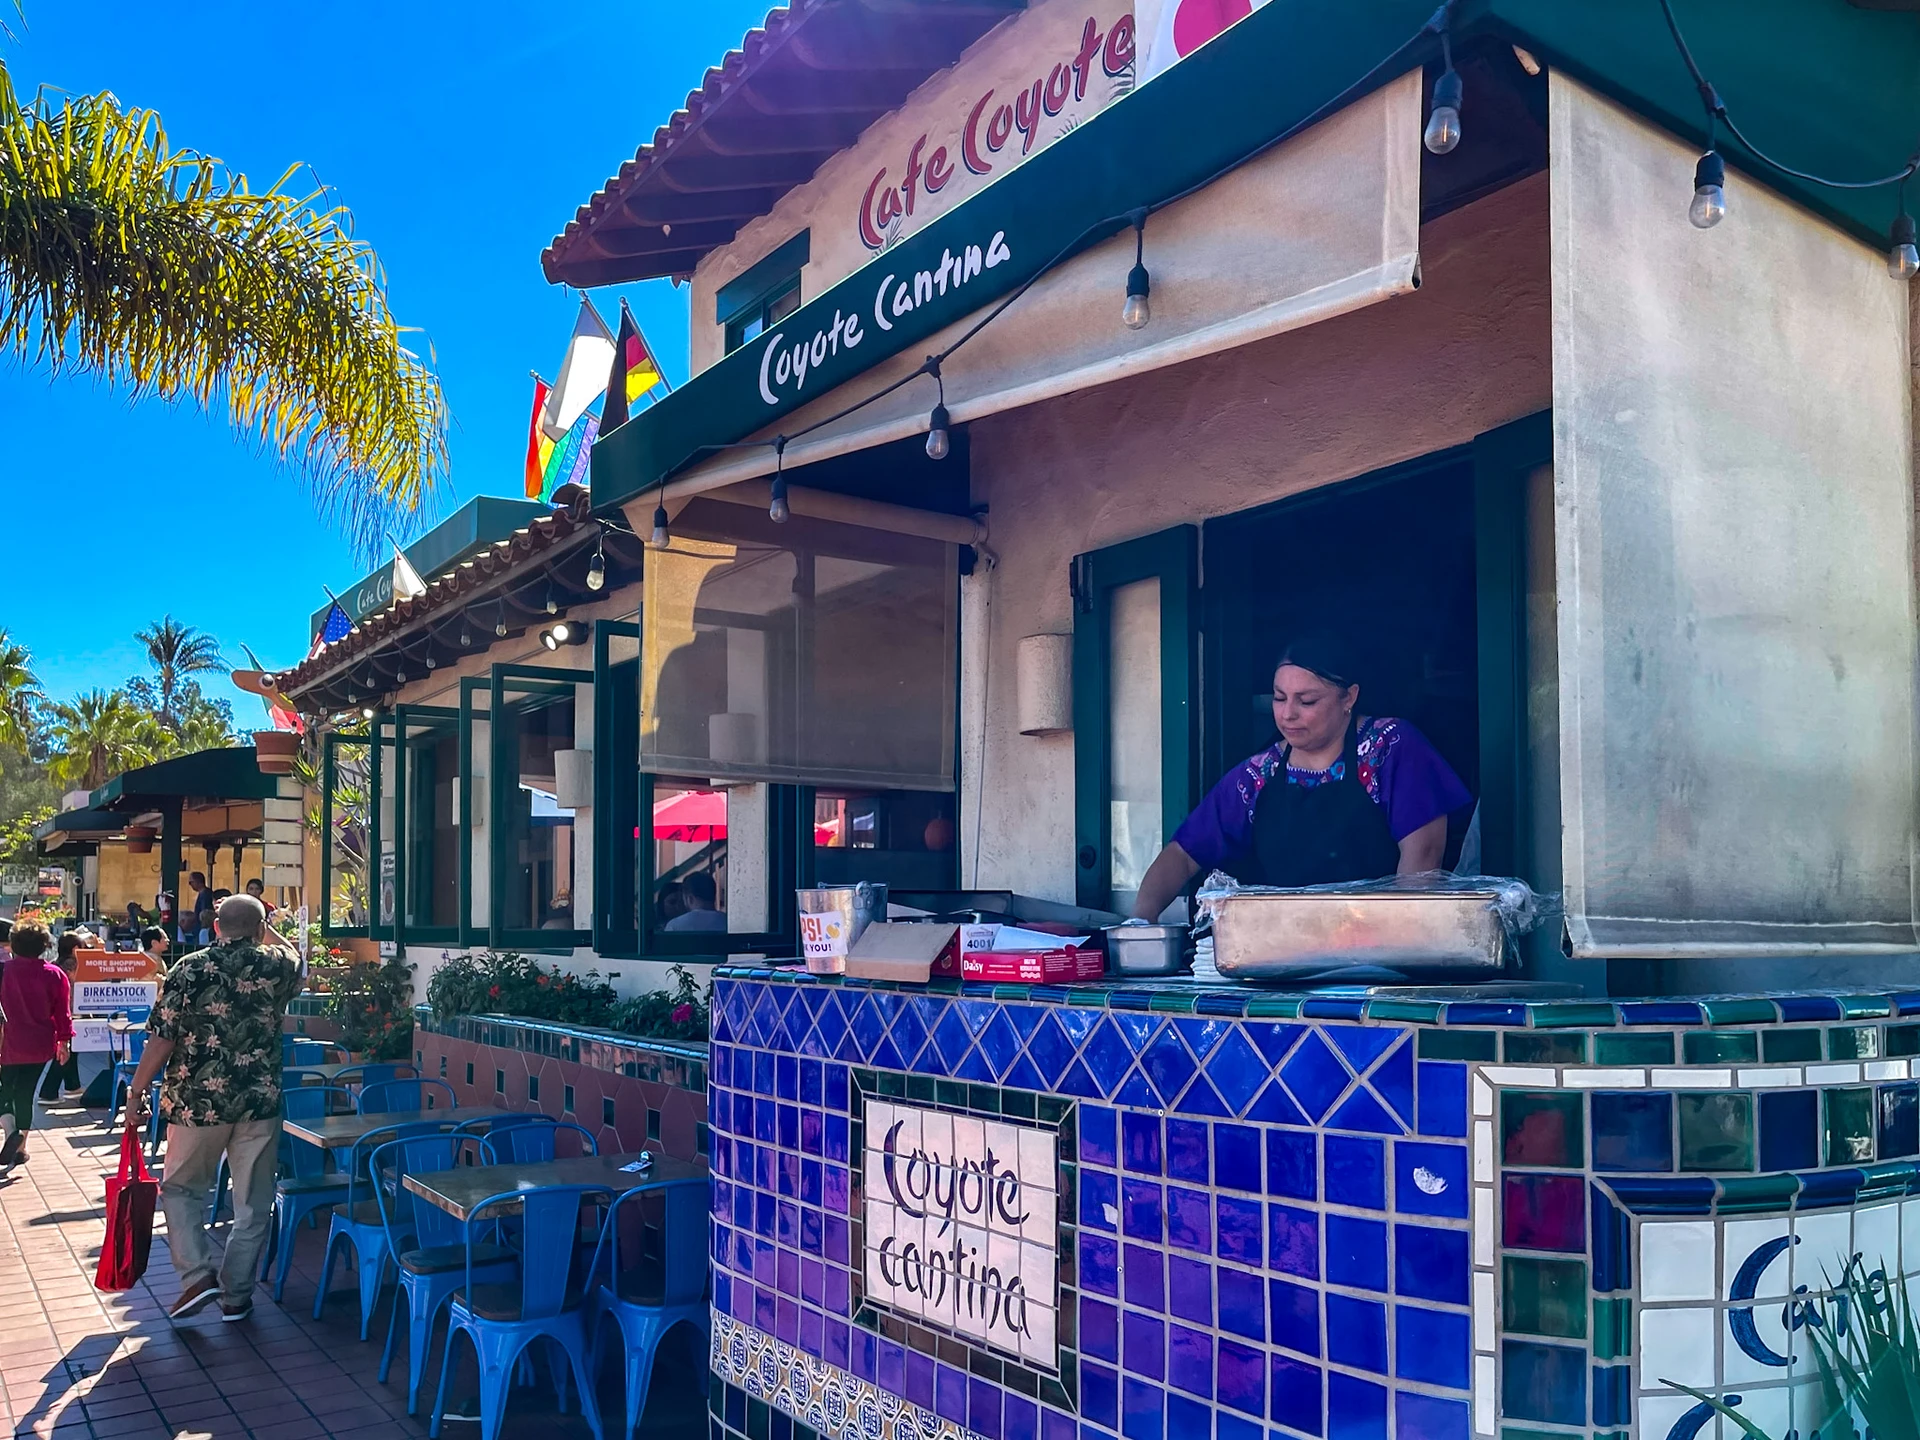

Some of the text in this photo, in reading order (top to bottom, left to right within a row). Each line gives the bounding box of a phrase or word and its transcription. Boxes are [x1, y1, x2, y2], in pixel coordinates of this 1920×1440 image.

[859, 13, 1135, 250] Cafe Coyote
[759, 230, 1010, 405] Coyote Cantina
[357, 575, 392, 614] Cafe Coy
[810, 943, 832, 952] YOU!
[963, 959, 984, 974] Daisy
[83, 987, 147, 997] BIRKENSTOCK
[883, 1119, 1030, 1239] Coyote
